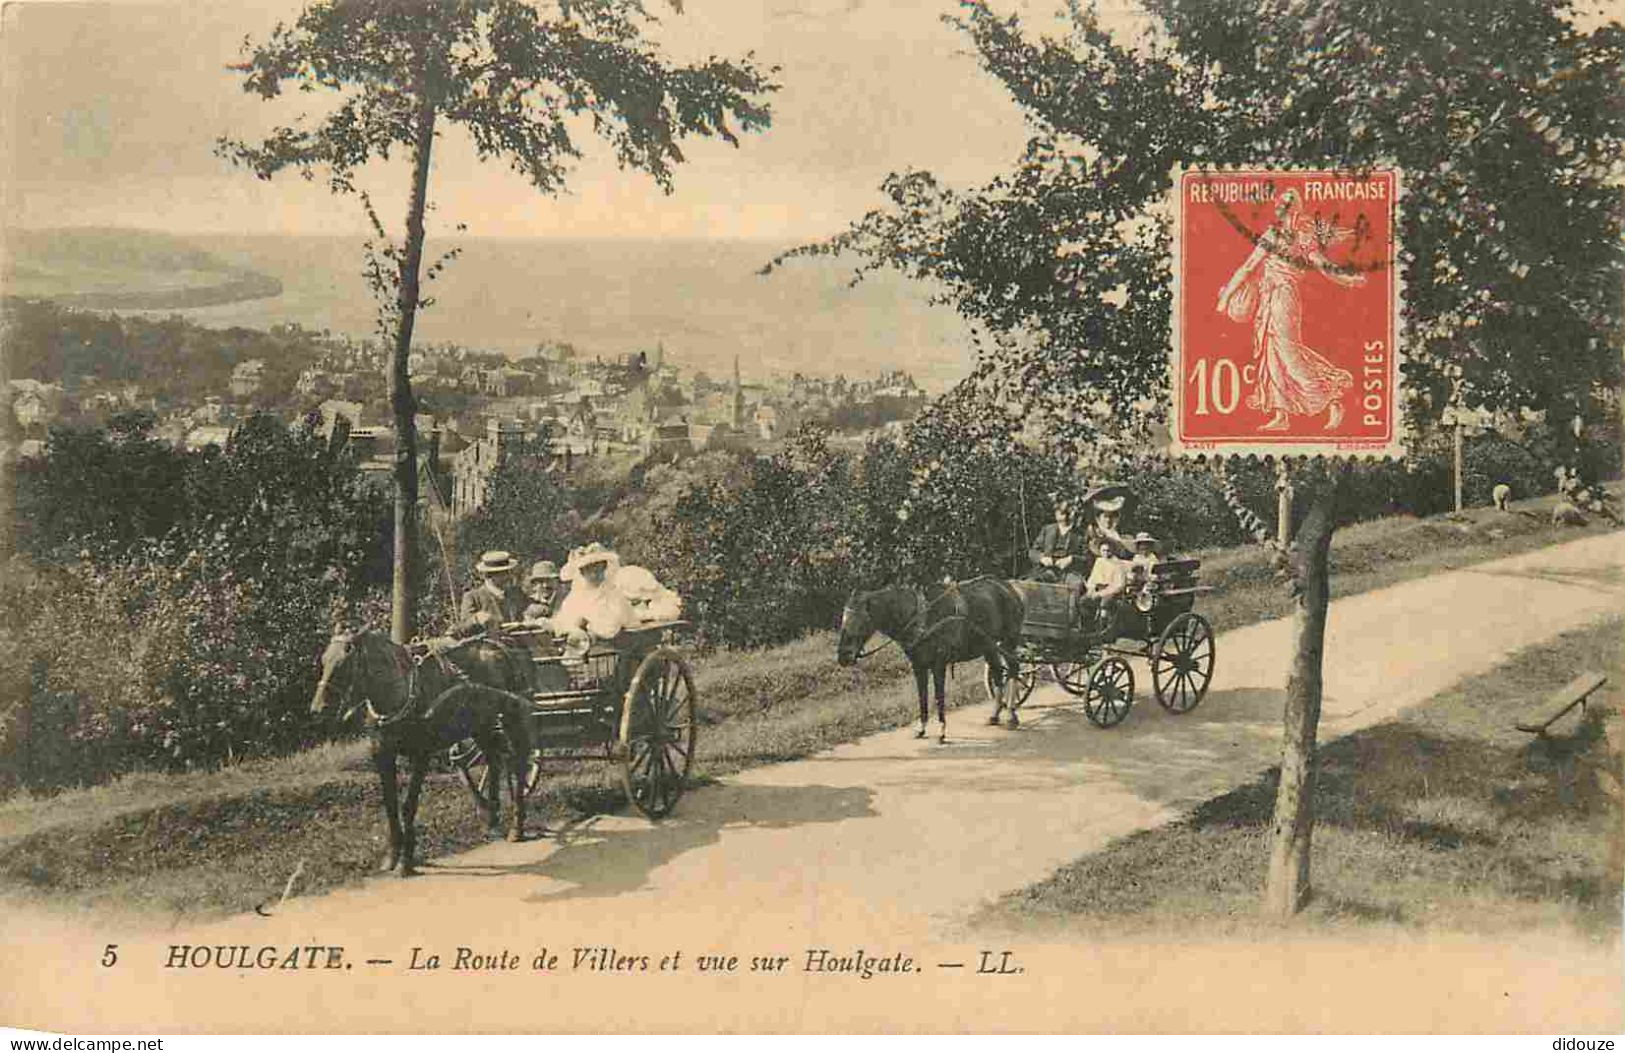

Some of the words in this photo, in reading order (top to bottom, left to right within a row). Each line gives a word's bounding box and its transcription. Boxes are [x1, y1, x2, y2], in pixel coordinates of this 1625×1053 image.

[1363, 340, 1384, 426] POSTES
[101, 943, 119, 968] 5
[164, 944, 353, 970] HOULGATE.
[408, 947, 441, 970] La
[451, 947, 520, 971] Route
[532, 947, 558, 971] de
[572, 947, 649, 972] Villers
[659, 950, 681, 971] et
[696, 956, 739, 972] vue
[750, 956, 790, 972] sur
[802, 949, 922, 980] Houlgate.
